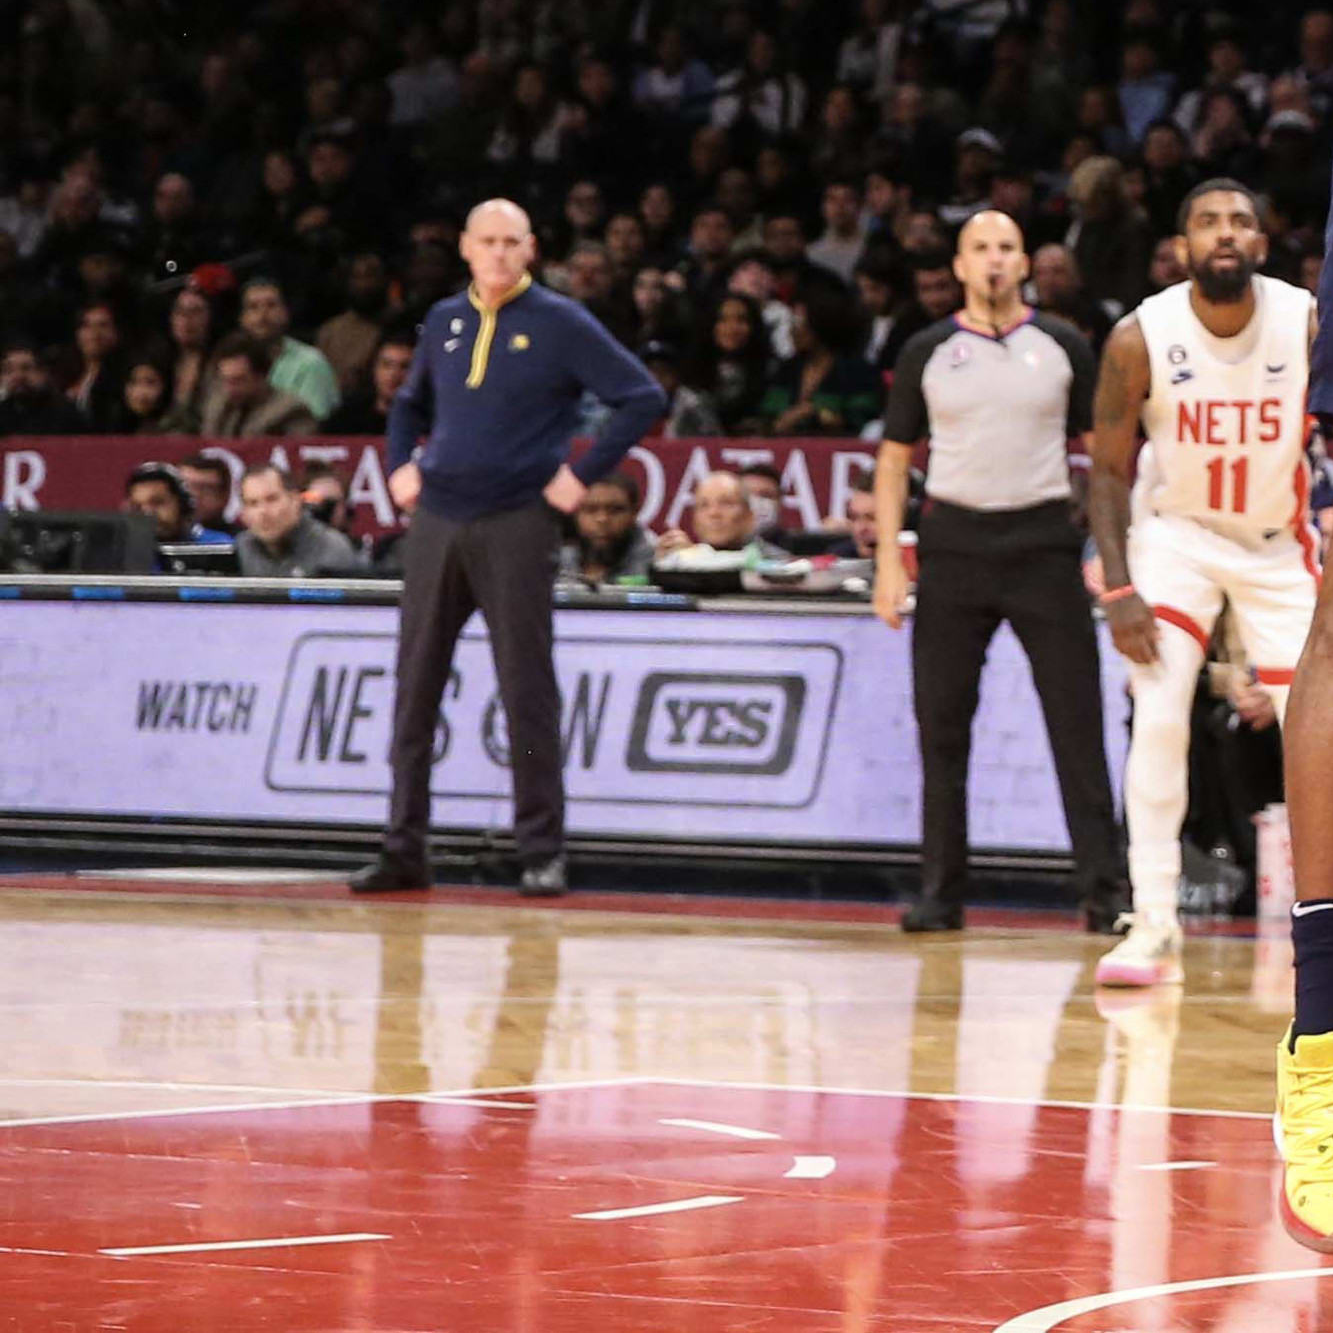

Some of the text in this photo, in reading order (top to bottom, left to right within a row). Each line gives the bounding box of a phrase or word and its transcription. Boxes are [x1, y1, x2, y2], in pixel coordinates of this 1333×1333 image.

[1177, 398, 1282, 445] NETS
[1206, 455, 1249, 514] 11
[136, 679, 257, 734] WATCH
[297, 666, 462, 766] NES
[665, 698, 773, 747] YES
